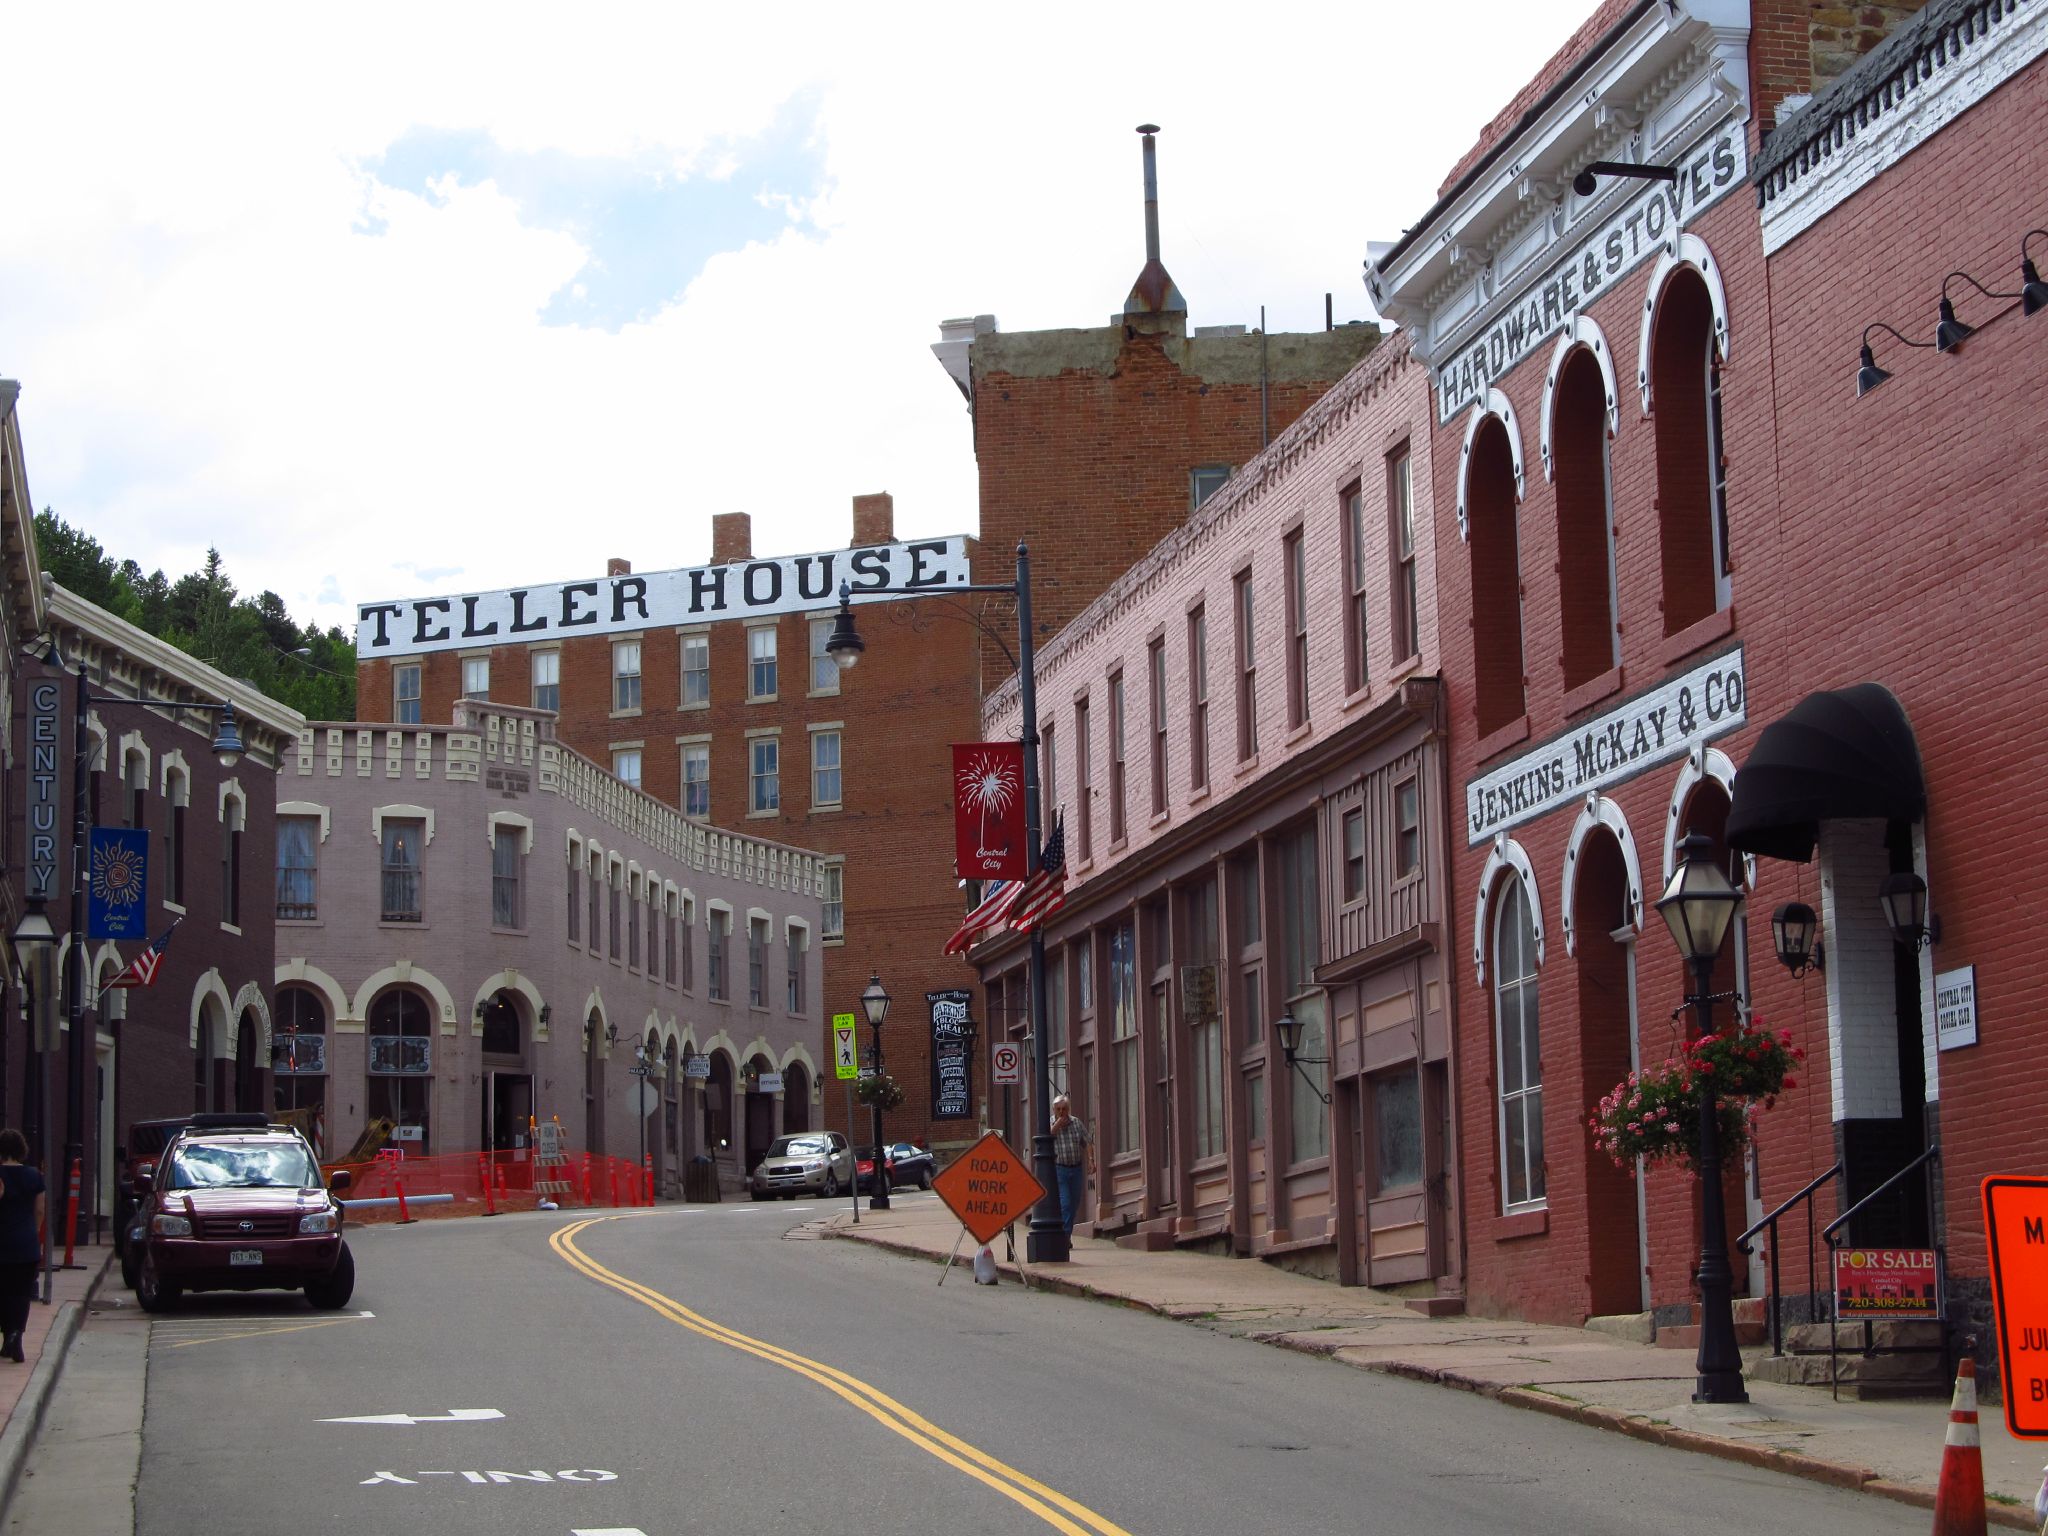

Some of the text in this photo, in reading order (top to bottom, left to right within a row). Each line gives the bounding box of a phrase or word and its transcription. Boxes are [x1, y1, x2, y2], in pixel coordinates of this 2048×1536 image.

[1442, 136, 1737, 417] HARDWARE & STOVES
[360, 540, 966, 647] TELLER HOUSE.
[1677, 685, 1697, 737] &
[33, 684, 57, 892] CENTURY
[975, 847, 1008, 858] Central
[982, 857, 1002, 870] City
[103, 912, 130, 922] Central
[108, 921, 126, 932] City
[927, 993, 947, 1001] TELLER
[1938, 984, 1972, 1010] CENTRAL CITY
[935, 1003, 965, 1019] PARKING
[940, 1017, 962, 1026] BLOC
[1940, 1010, 1957, 1031] SOCIAL
[630, 1067, 645, 1076] MAIN
[940, 1066, 965, 1079] MUSEUM
[941, 1105, 961, 1113] 1872
[970, 1158, 1009, 1174] ROAD
[967, 1178, 1008, 1195] WORK
[965, 1202, 1008, 1216] AHEAD
[2023, 1216, 2048, 1245] M
[1838, 1251, 1934, 1268] FOR SALE
[359, 1469, 619, 1485] ONLY
